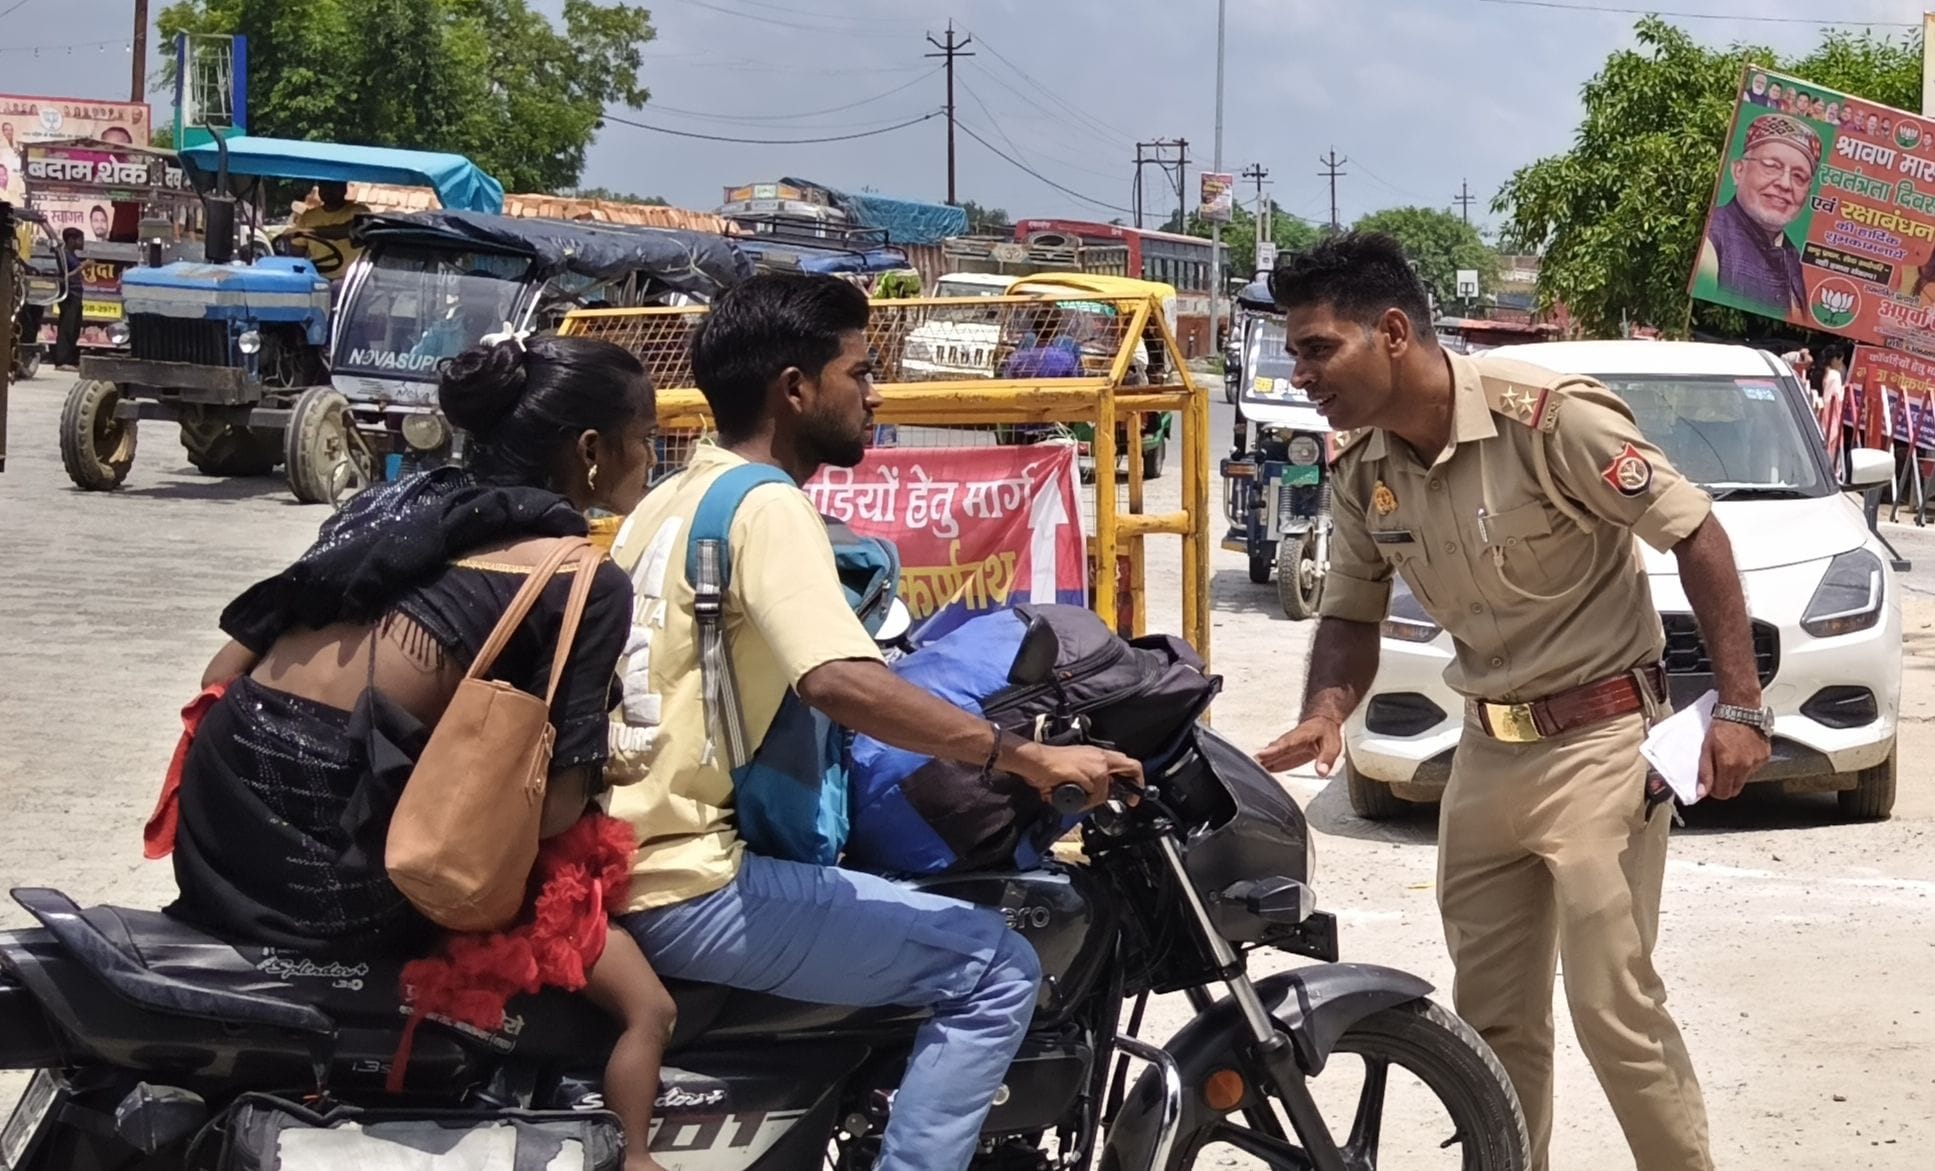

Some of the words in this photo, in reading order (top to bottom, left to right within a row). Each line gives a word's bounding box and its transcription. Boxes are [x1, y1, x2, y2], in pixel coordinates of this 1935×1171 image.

[28, 158, 94, 182] बदाम
[96, 154, 148, 184] शेक
[1836, 135, 1897, 170] श्रावण
[1810, 195, 1838, 214] एवं
[1840, 200, 1935, 243] रक्षाबंधन
[905, 463, 960, 539] हेतु
[962, 460, 1037, 520] मार्ग
[1000, 905, 1050, 929] ero
